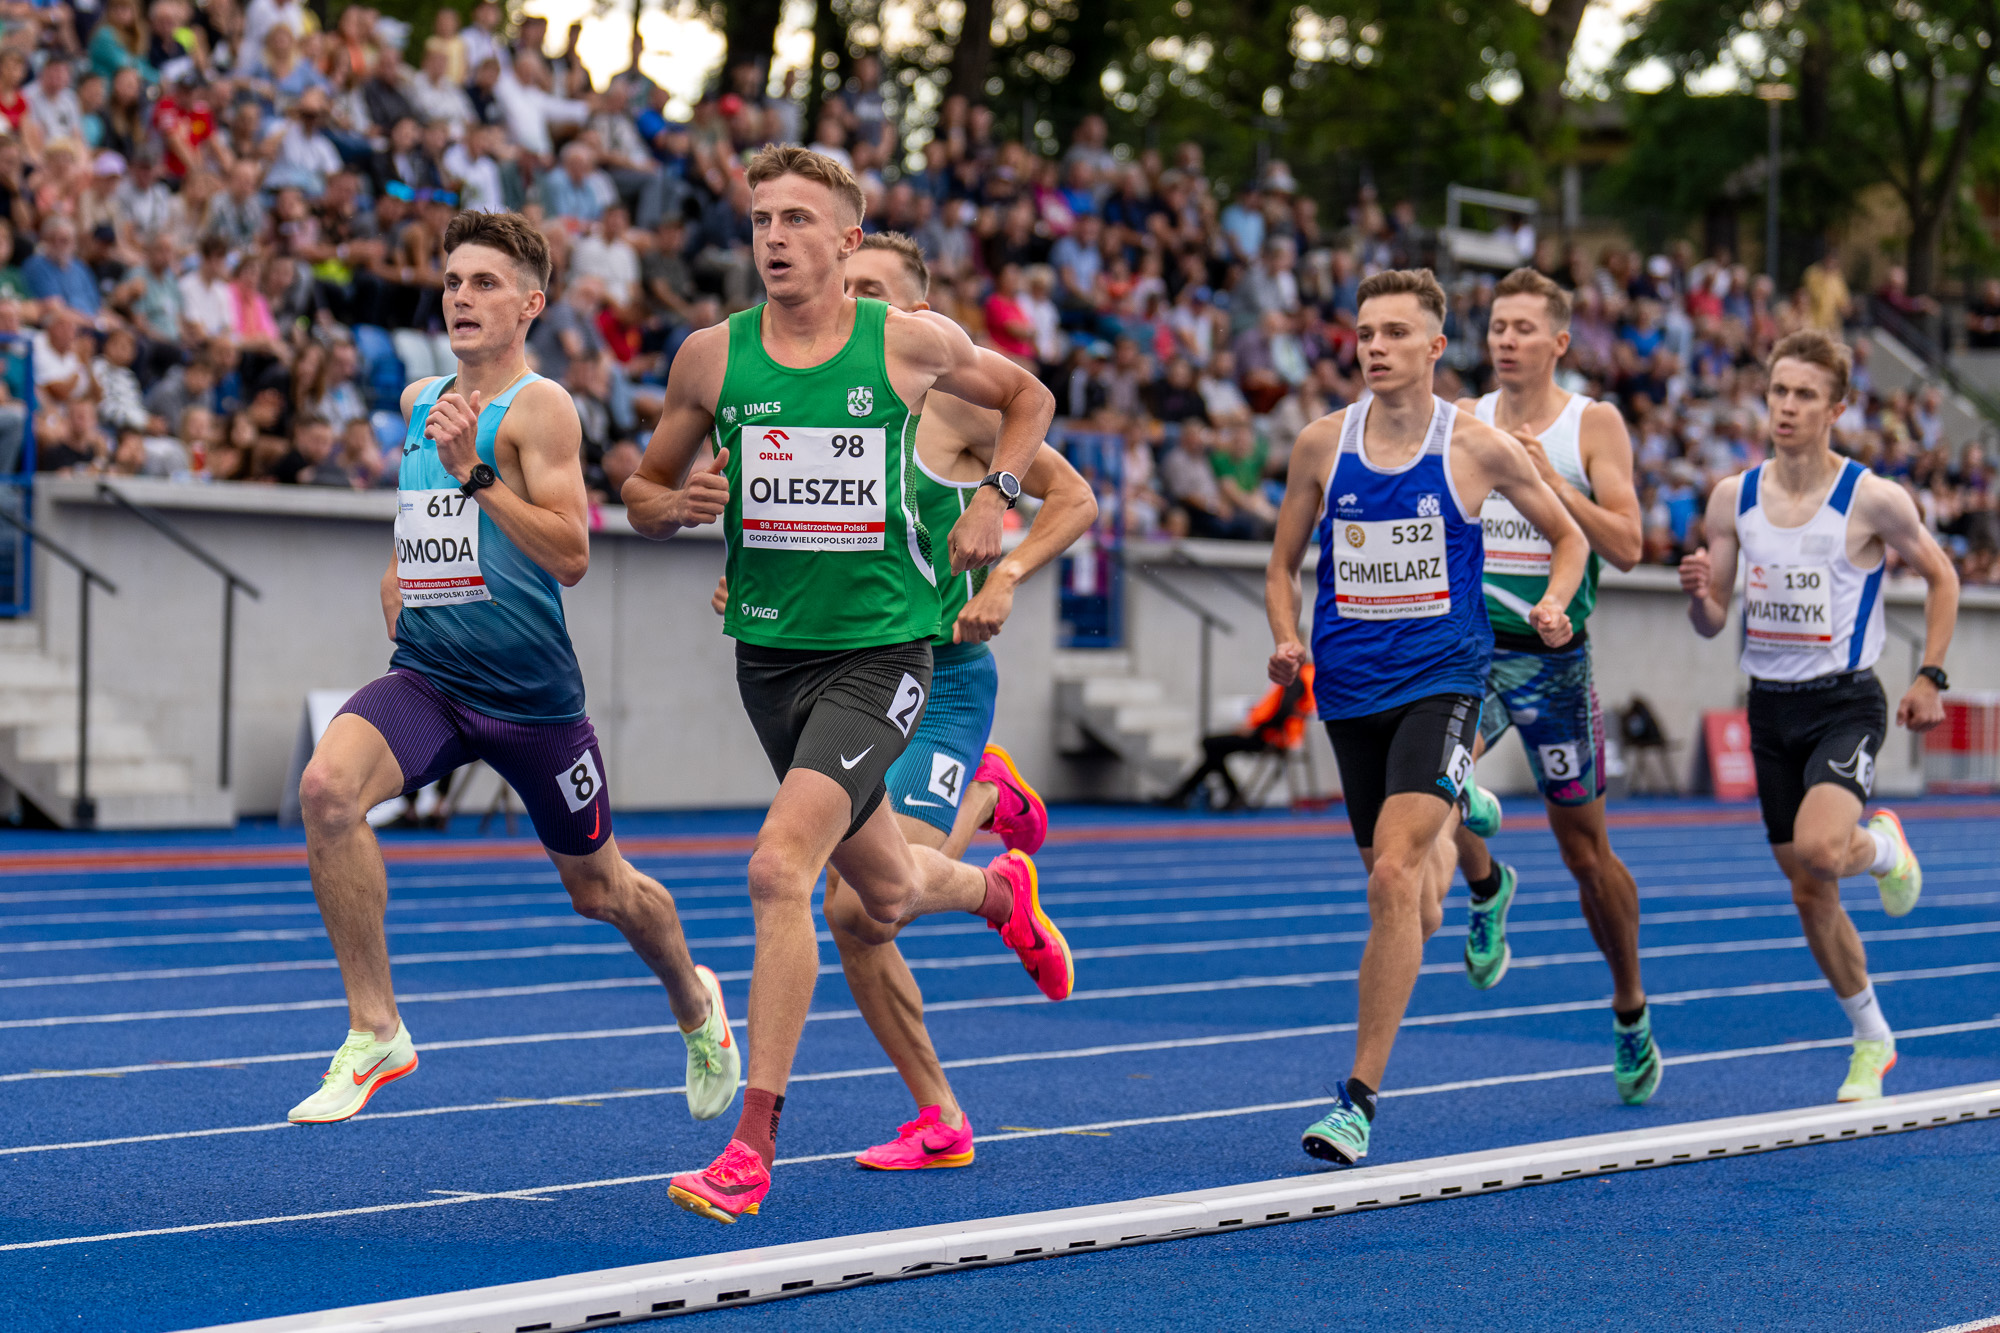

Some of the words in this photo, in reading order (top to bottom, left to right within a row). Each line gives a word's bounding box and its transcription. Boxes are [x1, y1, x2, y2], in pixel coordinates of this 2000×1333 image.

[743, 401, 782, 416] UMCS
[759, 452, 793, 461] ORLEN
[831, 434, 865, 458] 98
[749, 476, 878, 506] OLESZEK
[426, 494, 468, 518] 617
[759, 521, 772, 530] 99.
[773, 522, 792, 531] PZLA
[793, 522, 842, 532] Mistrzostwa
[843, 524, 868, 532] Polski
[1392, 523, 1433, 544] 532
[748, 533, 788, 543] GORZÓW
[790, 536, 855, 545] WIELKOPOLSKI
[857, 536, 878, 544] 2023
[1338, 557, 1442, 584] CHMIELARZ
[1785, 573, 1820, 589] 130
[413, 590, 465, 600] WIELKOPOLSKI
[465, 588, 484, 597] 2023
[414, 580, 450, 588] Mistrzostwa
[451, 578, 471, 587] Polski
[895, 686, 920, 731] 2
[1454, 755, 1471, 785] 5
[1548, 749, 1570, 776] 3
[570, 763, 594, 801] 8
[938, 763, 959, 798] 4
